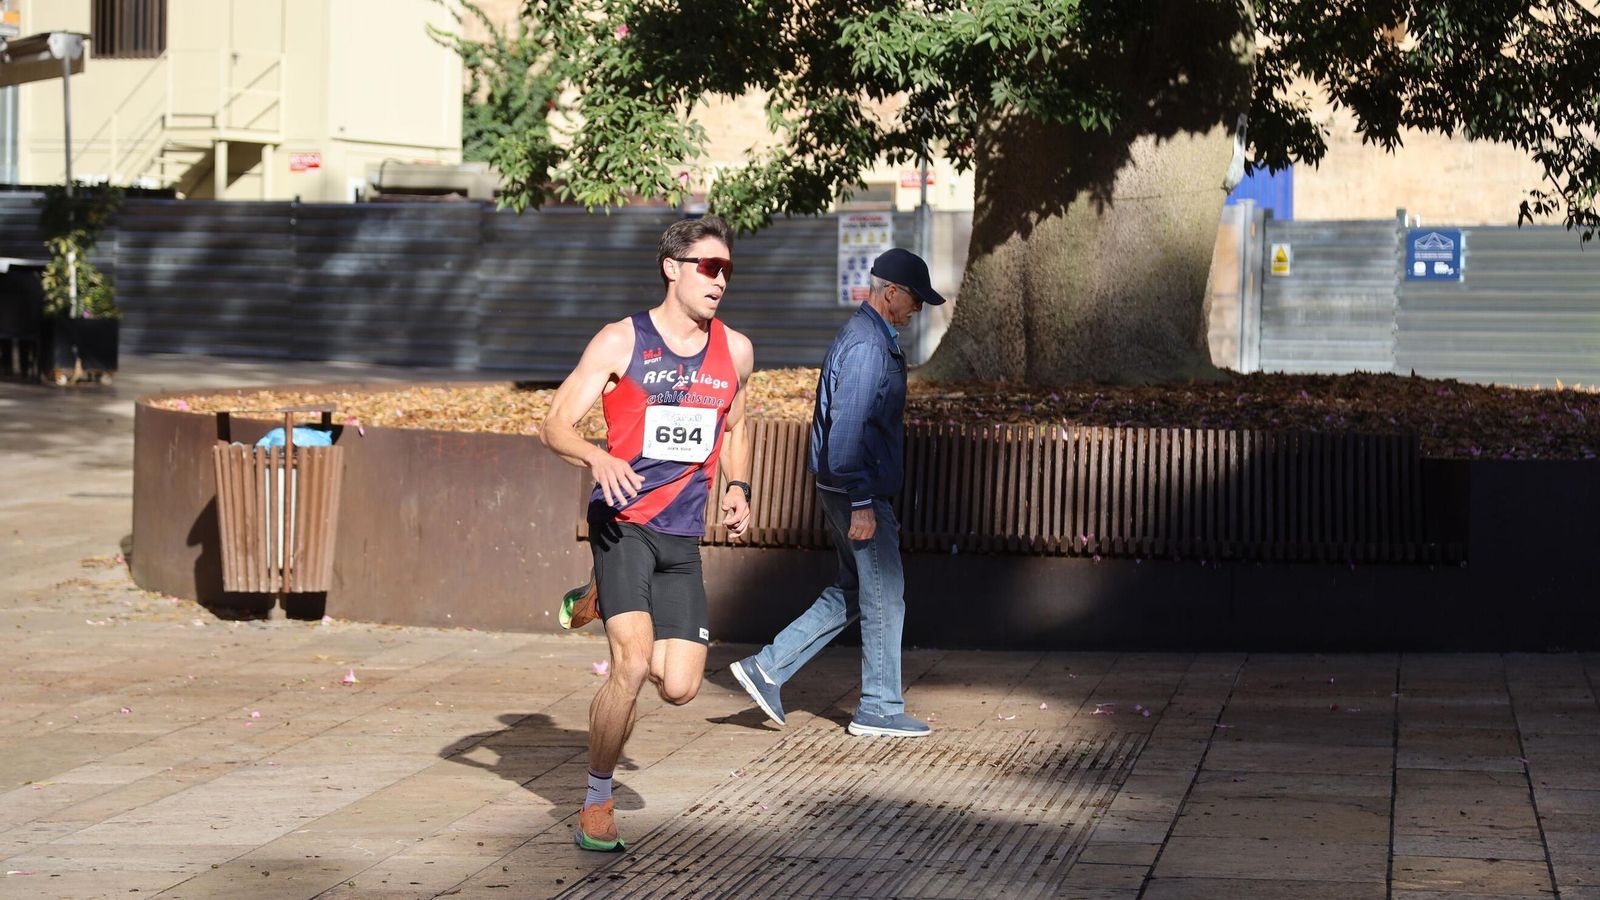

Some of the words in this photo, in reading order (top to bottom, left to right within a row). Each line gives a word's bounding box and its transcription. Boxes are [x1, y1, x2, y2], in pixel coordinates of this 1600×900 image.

[644, 357, 662, 365] SPORT
[644, 370, 677, 384] RFC
[691, 371, 728, 388] Liège
[647, 391, 724, 406] athlétisme
[655, 425, 702, 445] 694
